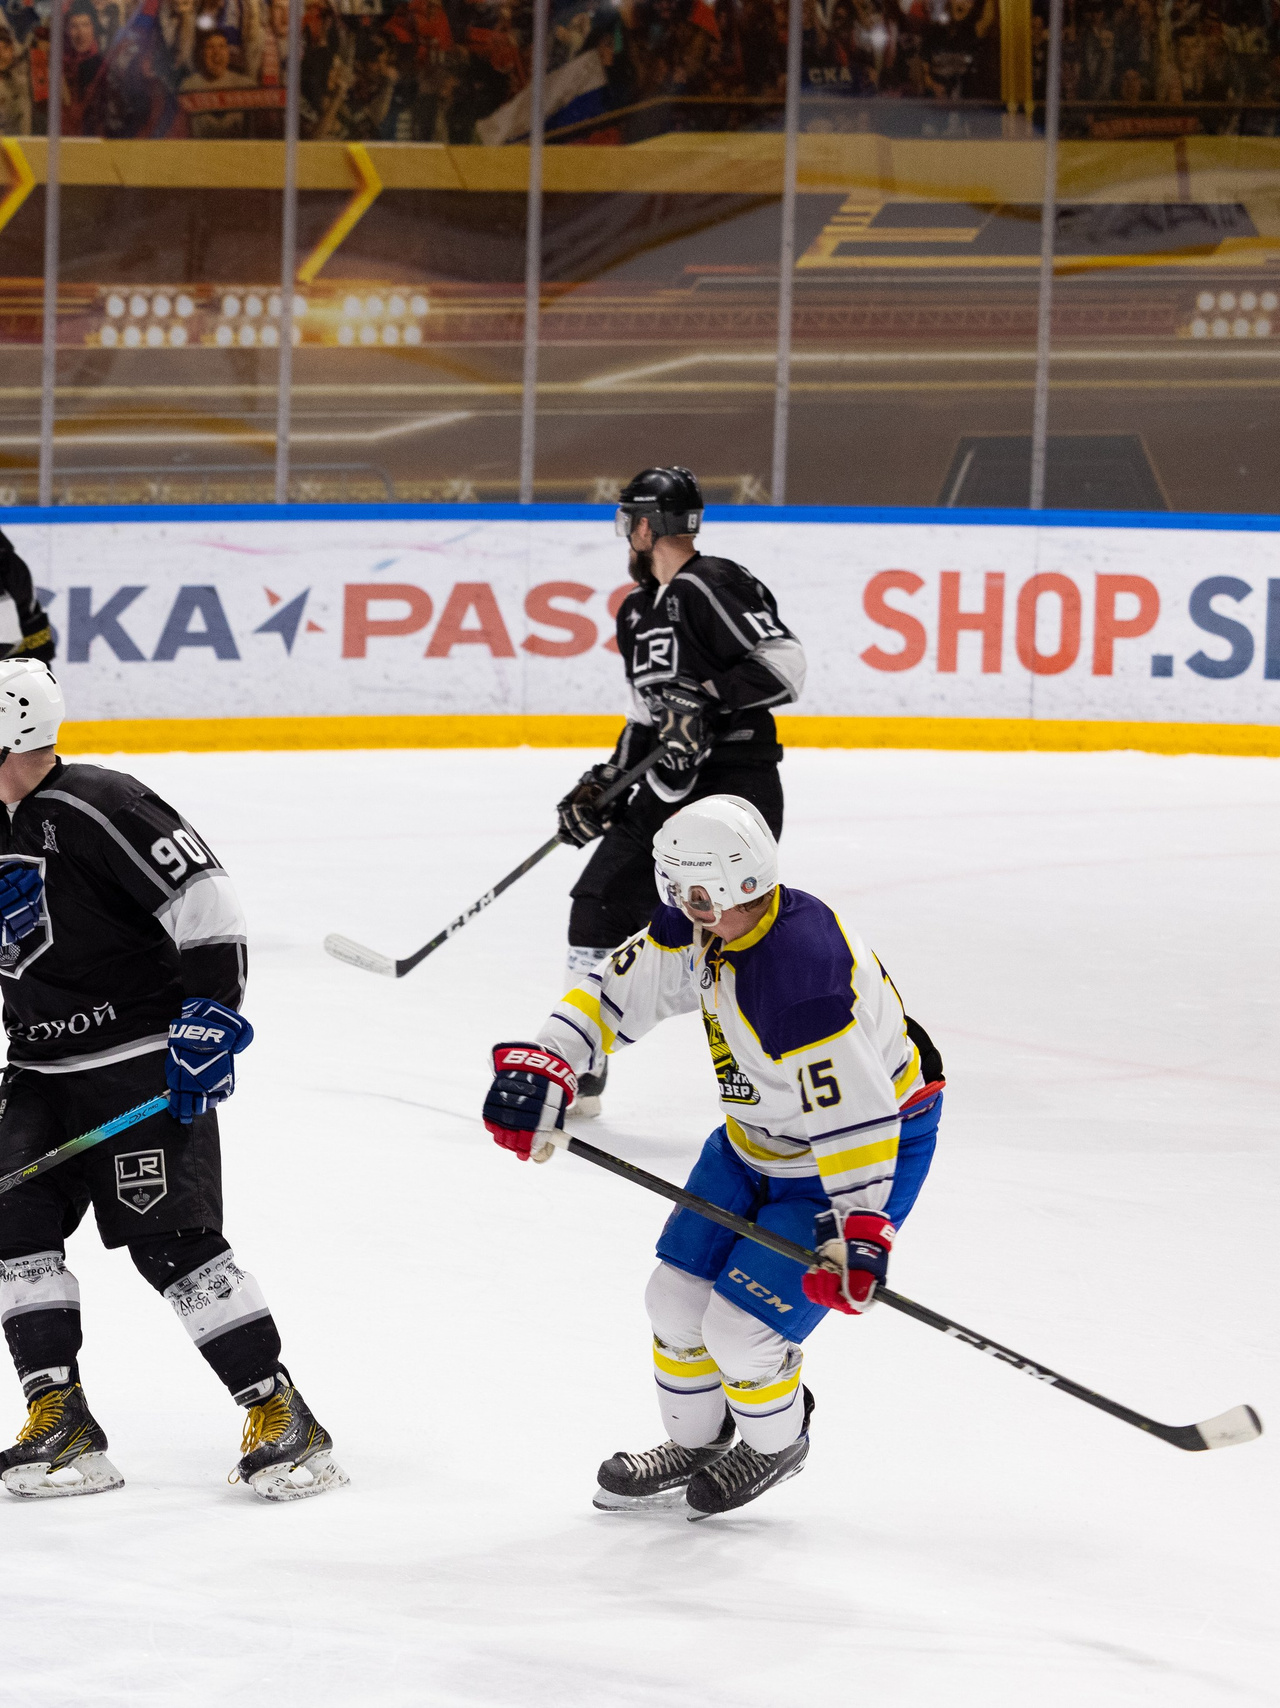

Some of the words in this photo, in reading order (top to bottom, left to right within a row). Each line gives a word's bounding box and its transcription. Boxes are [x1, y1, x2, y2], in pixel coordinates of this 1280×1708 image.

[150, 828, 208, 881] 90
[680, 860, 713, 868] BAUER
[446, 887, 495, 938] CCM
[168, 1024, 226, 1043] UER
[502, 1050, 578, 1095] BAUE
[797, 1058, 842, 1114] 15
[22, 1165, 39, 1178] PRO
[119, 1156, 161, 1179] LR
[728, 1266, 794, 1314] CCM
[944, 1324, 1060, 1385] CCM
[657, 1473, 693, 1489] CCM
[750, 1468, 779, 1495] CCM
